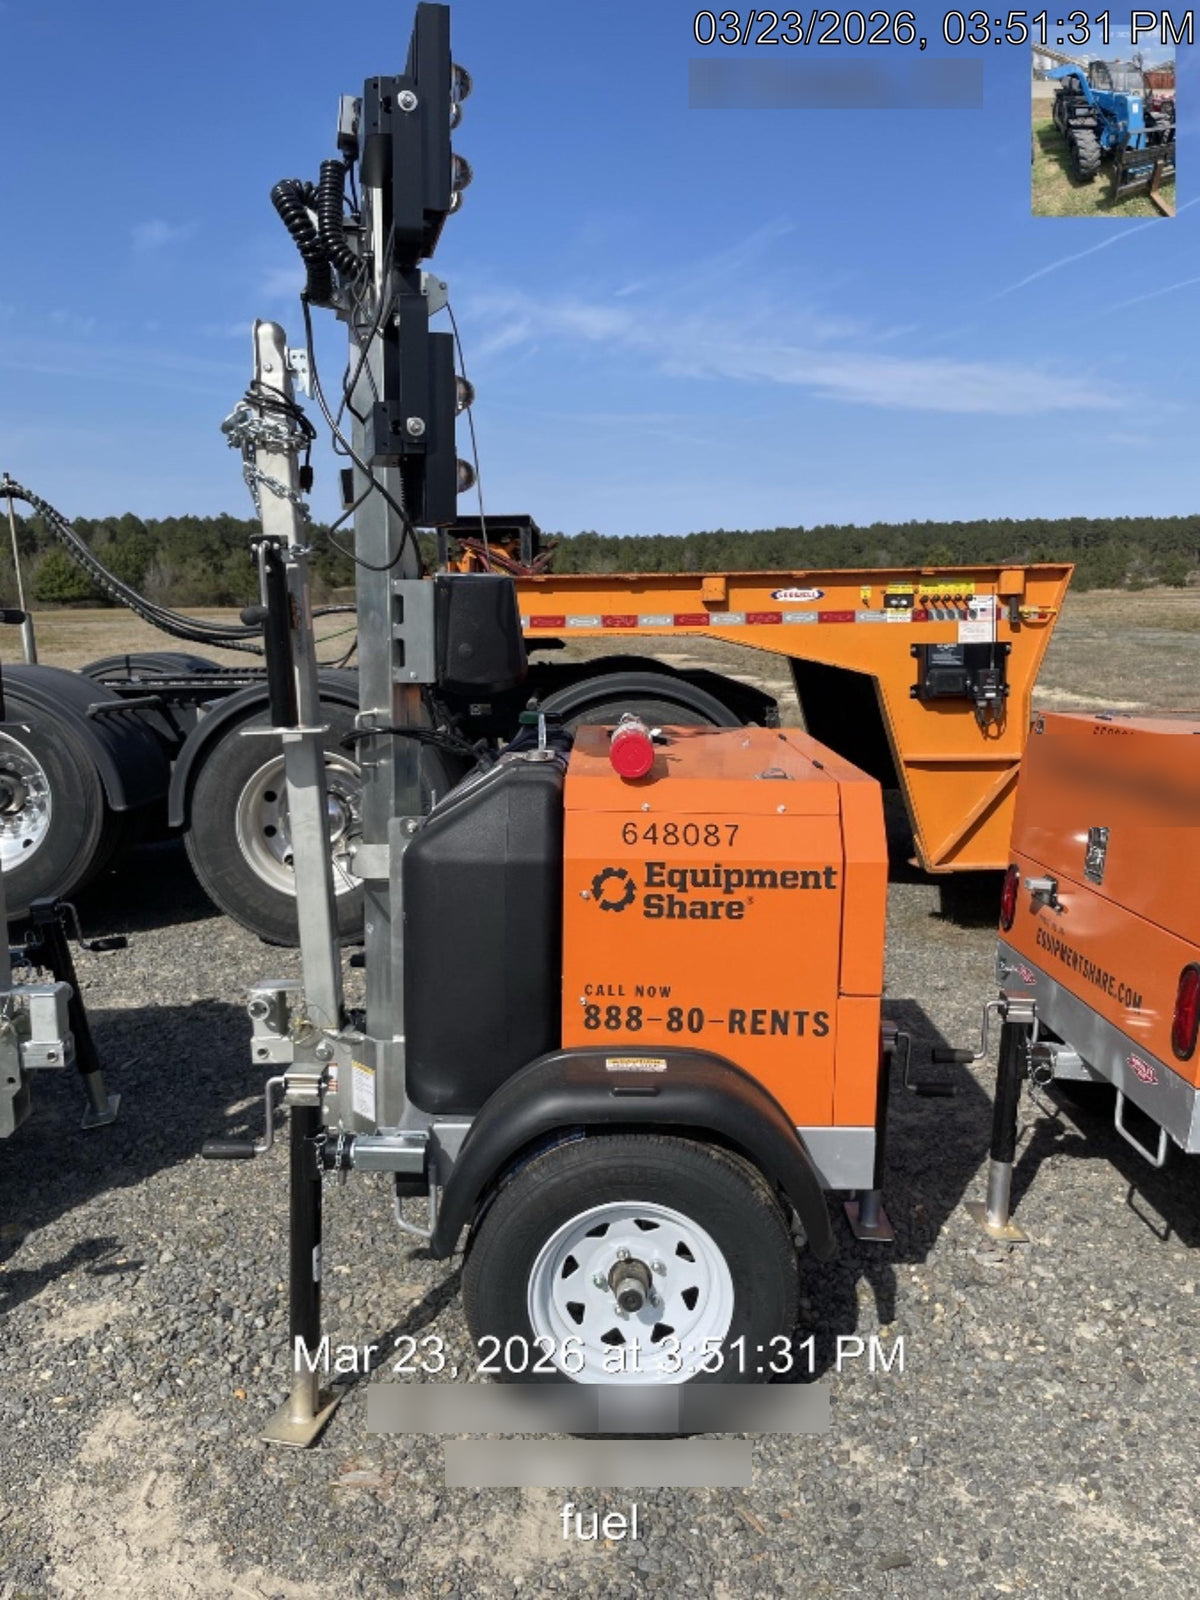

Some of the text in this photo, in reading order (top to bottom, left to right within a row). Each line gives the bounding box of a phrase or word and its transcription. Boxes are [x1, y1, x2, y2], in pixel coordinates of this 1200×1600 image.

[622, 823, 740, 847] 648087
[644, 862, 837, 893] Equipment
[584, 984, 671, 998] CALL NOW
[584, 1005, 830, 1037] 888-80-RENTS
